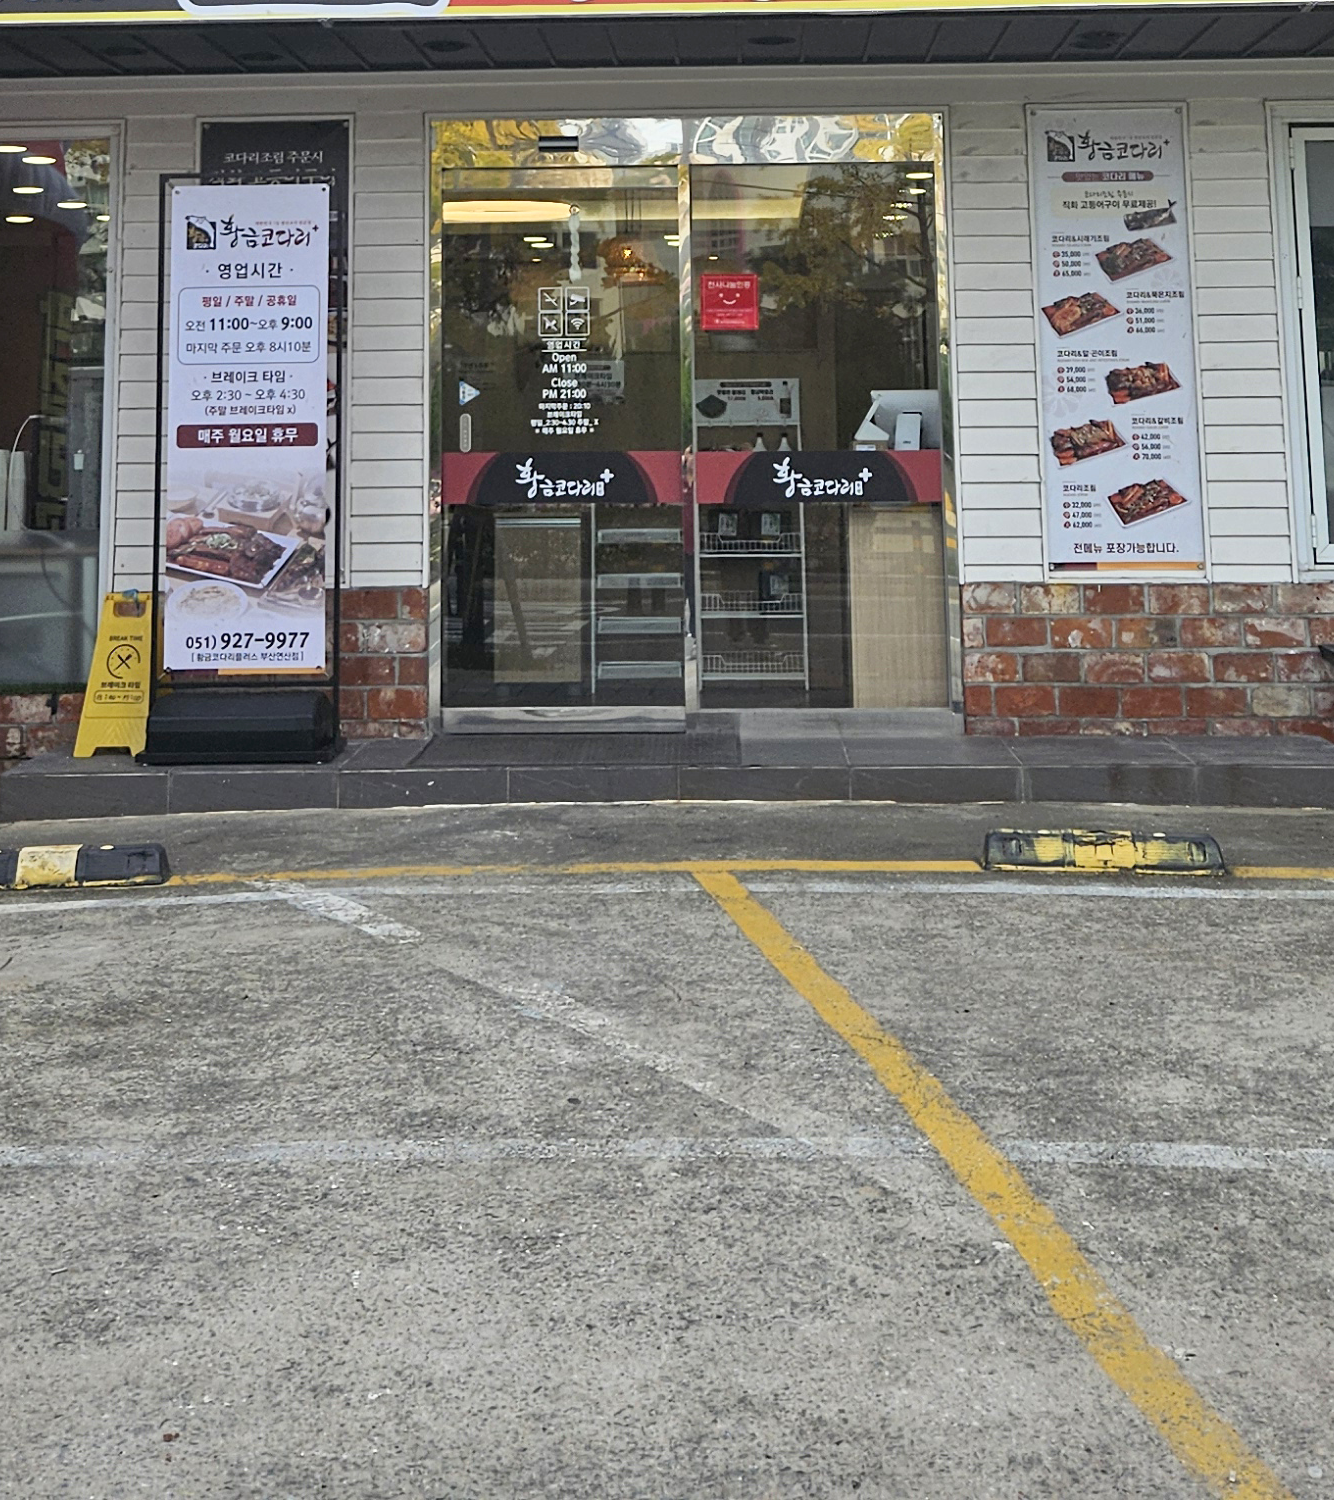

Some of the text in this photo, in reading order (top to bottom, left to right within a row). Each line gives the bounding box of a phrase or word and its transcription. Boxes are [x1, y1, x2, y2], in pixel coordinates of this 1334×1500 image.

[218, 263, 283, 279] 영업시간
[202, 296, 222, 308] 평일
[234, 295, 255, 307] 주말
[266, 295, 297, 306] 공휴일
[185, 320, 206, 332] 오전
[281, 316, 313, 330] 9:00
[186, 341, 312, 354] 마지막 주문 오후 8시10분
[552, 353, 577, 364] Open
[542, 363, 587, 373] AM 11:00
[211, 370, 286, 383] 브레이크 타임
[551, 377, 578, 388] Close
[191, 389, 212, 401] 오후
[216, 389, 242, 401] 2:30
[255, 389, 276, 400] 오후
[279, 388, 306, 400] 4:30
[542, 388, 587, 399] PM 21:00
[204, 405, 227, 416] (주말
[229, 405, 285, 415] 브레이크타임
[197, 427, 299, 444] 매주 월요일 휴무
[185, 632, 310, 650] 051) 927-9977
